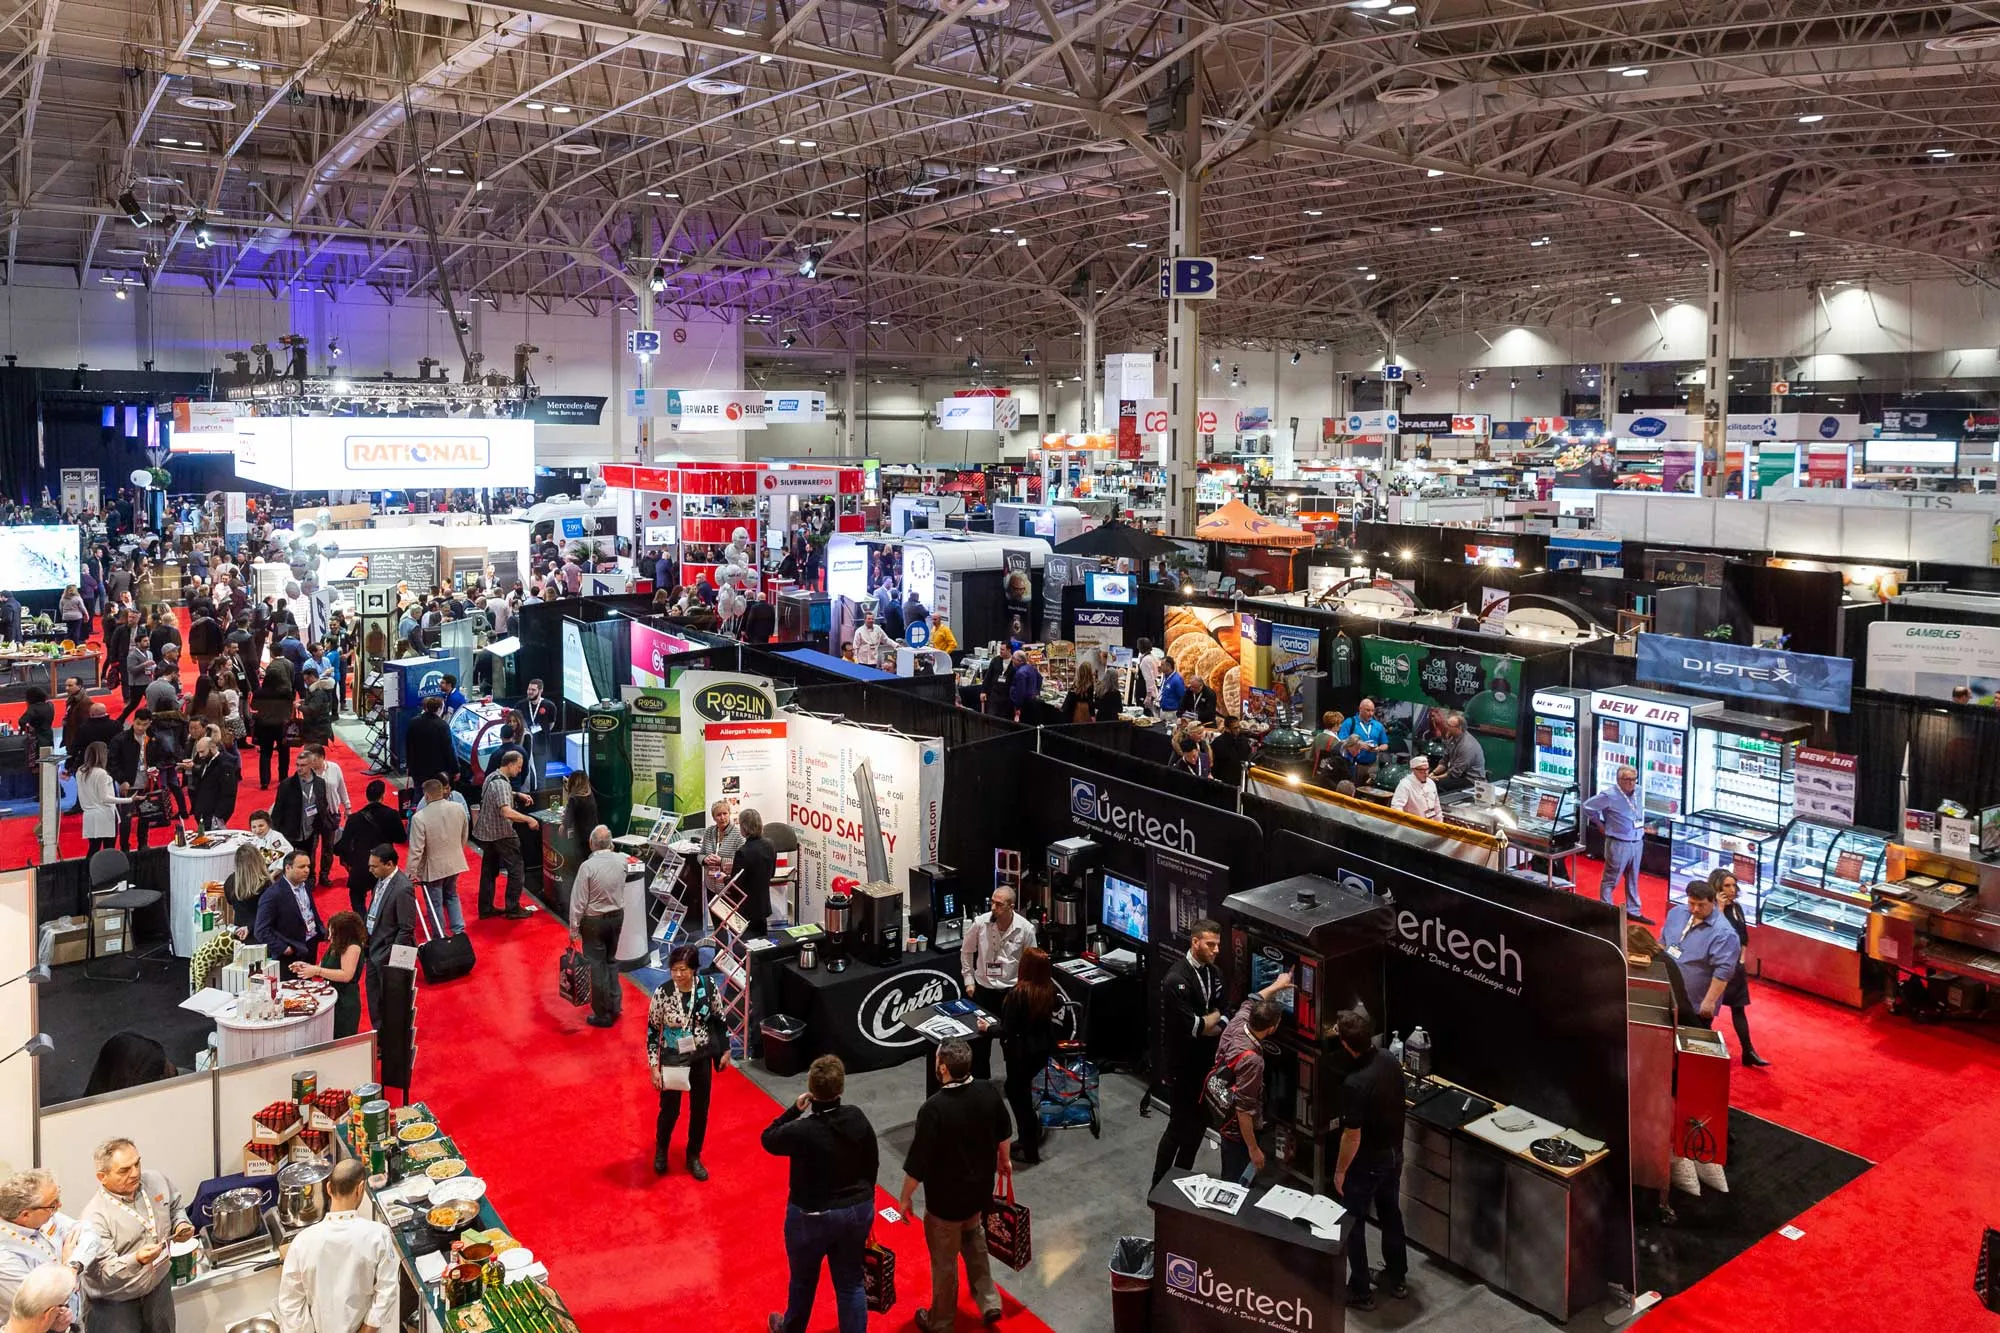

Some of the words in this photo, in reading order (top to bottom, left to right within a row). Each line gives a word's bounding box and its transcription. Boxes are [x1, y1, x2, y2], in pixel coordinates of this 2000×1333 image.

[1162, 259, 1170, 297] HALL
[1176, 261, 1214, 292] B
[637, 332, 659, 351] B
[1387, 366, 1402, 379] B
[547, 402, 597, 410] Mercedes-Benz
[745, 405, 764, 414] SILVE
[1728, 422, 1762, 431] cilitators
[354, 443, 483, 462] RATIONAL
[1656, 570, 1704, 584] Belcolade
[1078, 612, 1120, 624] KRONOS
[1906, 628, 1962, 640] GAMBLES
[1280, 638, 1309, 651] kontos
[1382, 655, 1396, 667] Big
[1432, 658, 1446, 668] Grill
[1370, 662, 1396, 674] Green
[1683, 657, 1793, 684] DISTEX
[1380, 672, 1396, 684] Egg
[1422, 670, 1448, 683] Smoke
[638, 698, 663, 707] ROSLIN
[707, 692, 764, 715] ROSLIN
[1598, 699, 1639, 715] NEW
[1645, 708, 1680, 723] AIR
[592, 718, 612, 726] ROSLIN
[720, 728, 746, 736] Allergen
[805, 757, 828, 768] shellfish
[1799, 751, 1854, 768] NEW-AIR
[788, 779, 806, 790] HACCP
[820, 776, 838, 788] pests
[872, 772, 894, 784] urant
[892, 792, 904, 801] coli
[822, 802, 838, 812] freeze
[790, 803, 832, 833] FOOD
[836, 818, 897, 854] SAFY
[928, 800, 937, 864] inCan.com
[828, 838, 848, 851] kitchen
[804, 846, 822, 860] meat
[832, 850, 847, 862] raw
[828, 862, 858, 879] consumers
[1157, 857, 1183, 872] Excellence
[1397, 910, 1522, 982] ertech
[1428, 952, 1450, 969] Dare
[1452, 964, 1461, 973] to
[1463, 968, 1504, 990] challenge
[1506, 986, 1522, 996] us!
[873, 978, 944, 1040] Curtis
[1240, 1311, 1258, 1323] Dare
